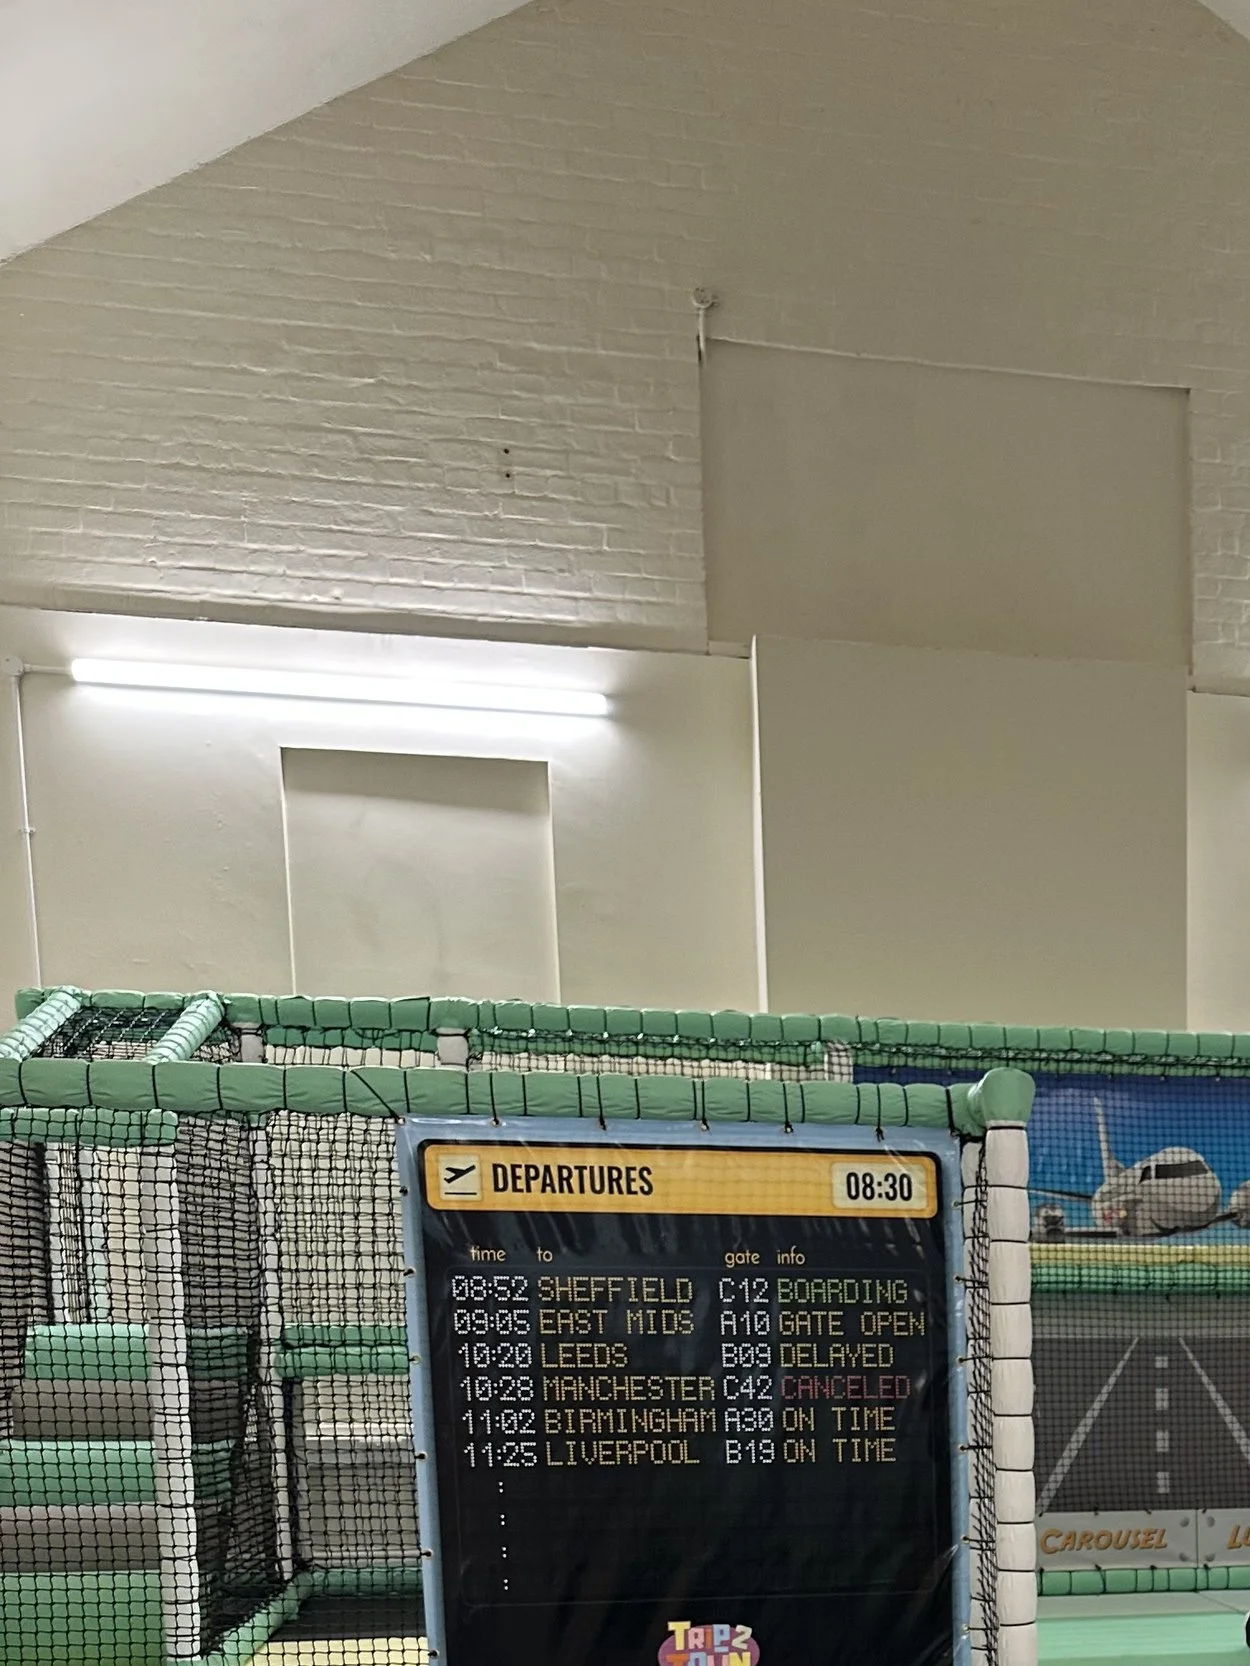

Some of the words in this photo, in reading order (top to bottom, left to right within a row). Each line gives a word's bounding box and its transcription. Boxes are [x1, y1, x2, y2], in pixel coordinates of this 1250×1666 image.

[492, 1163, 654, 1195] DEPARTURES
[846, 1172, 913, 1201] 08:30
[469, 1246, 506, 1262] time
[536, 1246, 553, 1262] to
[724, 1249, 761, 1269] gate
[776, 1246, 806, 1265] info
[452, 1275, 529, 1302] 08:52
[537, 1276, 694, 1303] SHEFFIELD
[718, 1277, 770, 1303] C12
[777, 1277, 909, 1304] BOARDING
[453, 1309, 531, 1335] 09:05
[539, 1309, 608, 1335] EAST
[627, 1309, 695, 1335] MIDS
[720, 1310, 770, 1335] A10
[779, 1311, 844, 1336] GATE
[861, 1311, 926, 1336] OPEN
[458, 1343, 532, 1368] 10:20
[540, 1343, 628, 1368] LEEDS
[722, 1343, 772, 1368] B09
[779, 1343, 894, 1368] DELAYED
[460, 1376, 534, 1401] 10:28
[543, 1376, 715, 1401] MANCHESTER
[723, 1375, 773, 1400] C42
[781, 1375, 911, 1399] CANCELED
[462, 1409, 536, 1434] 11:02
[544, 1408, 717, 1433] BIRMINGHAM
[724, 1407, 774, 1432] A30
[782, 1407, 815, 1432] ON
[831, 1406, 895, 1431] TIME
[463, 1442, 537, 1467] 11:25
[546, 1440, 700, 1466] LIVERPOOL
[725, 1439, 775, 1464] B19
[783, 1438, 816, 1463] ON
[832, 1438, 896, 1463] TIME
[1040, 1527, 1168, 1554] CAROUSEL
